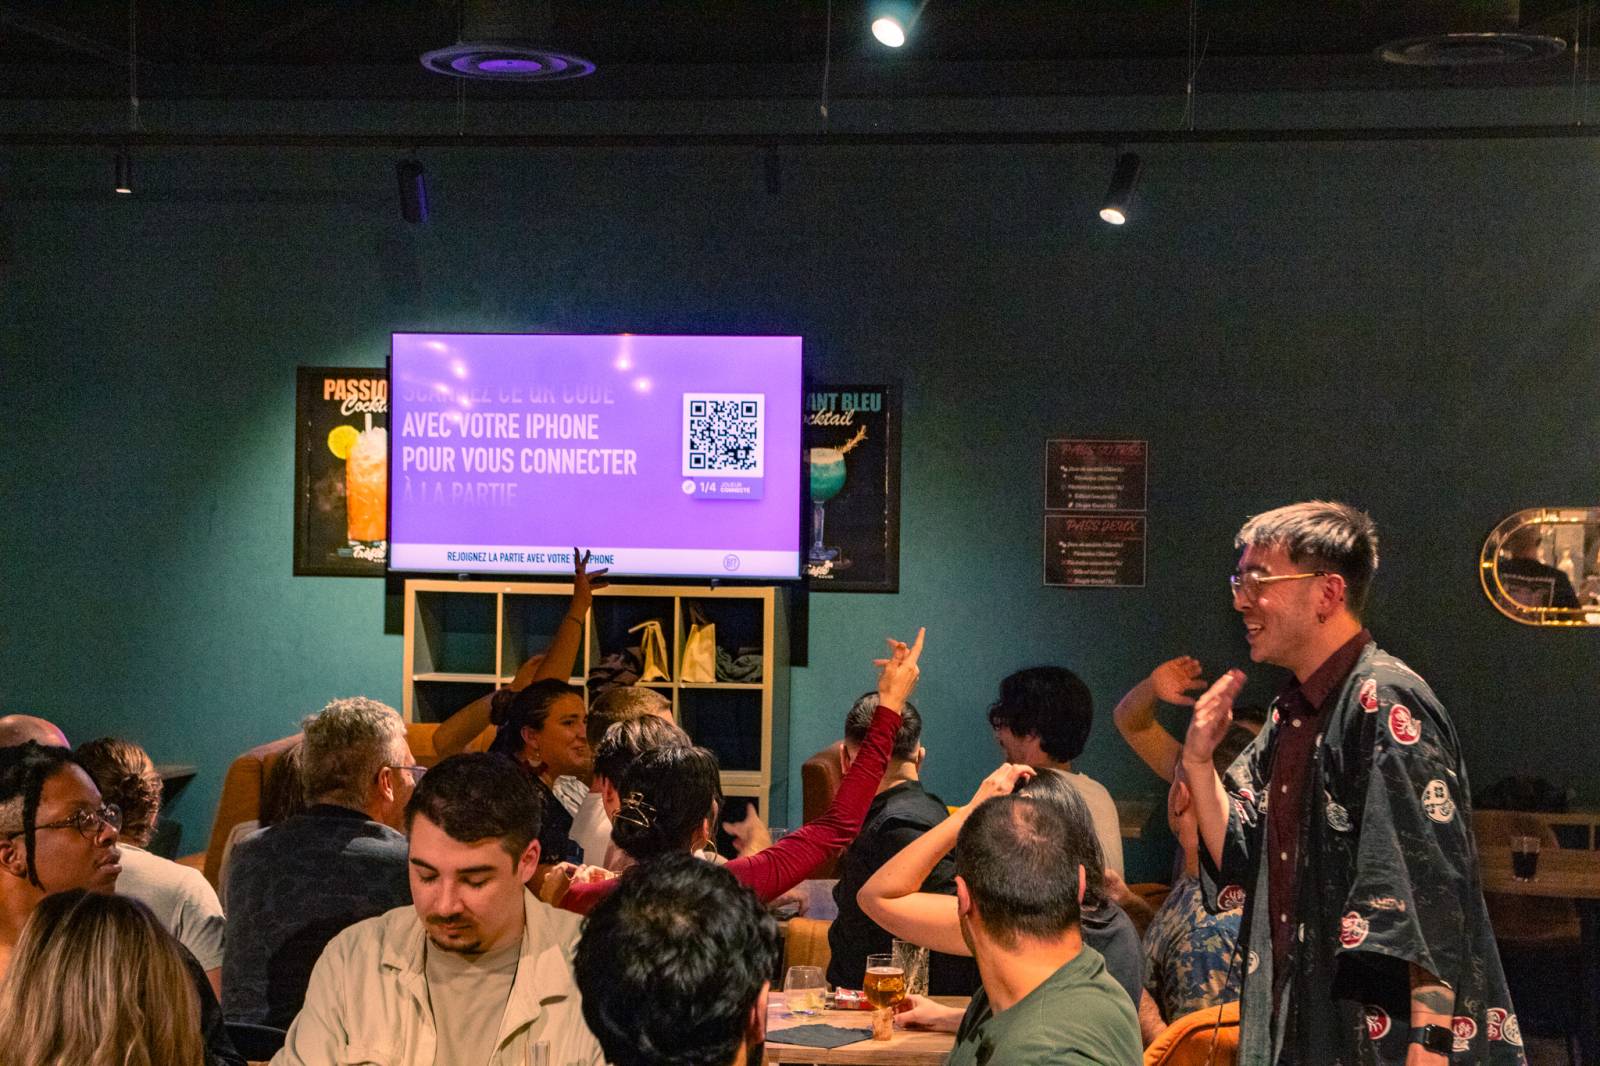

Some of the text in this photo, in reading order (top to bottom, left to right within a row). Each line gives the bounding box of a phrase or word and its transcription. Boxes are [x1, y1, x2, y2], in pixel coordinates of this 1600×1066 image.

[841, 392, 882, 412] BLEU
[402, 412, 600, 440] AVEC VOTRE IPHONE
[402, 446, 638, 475] POUR VOUS CONNECTER
[452, 481, 518, 506] PARTIE
[700, 481, 717, 494] 1/4
[447, 551, 487, 562] REJOIGNEZ
[488, 552, 498, 563] LA
[500, 552, 525, 563] PARTIE
[526, 553, 545, 563] AVEC
[547, 553, 571, 564] VOTRE
